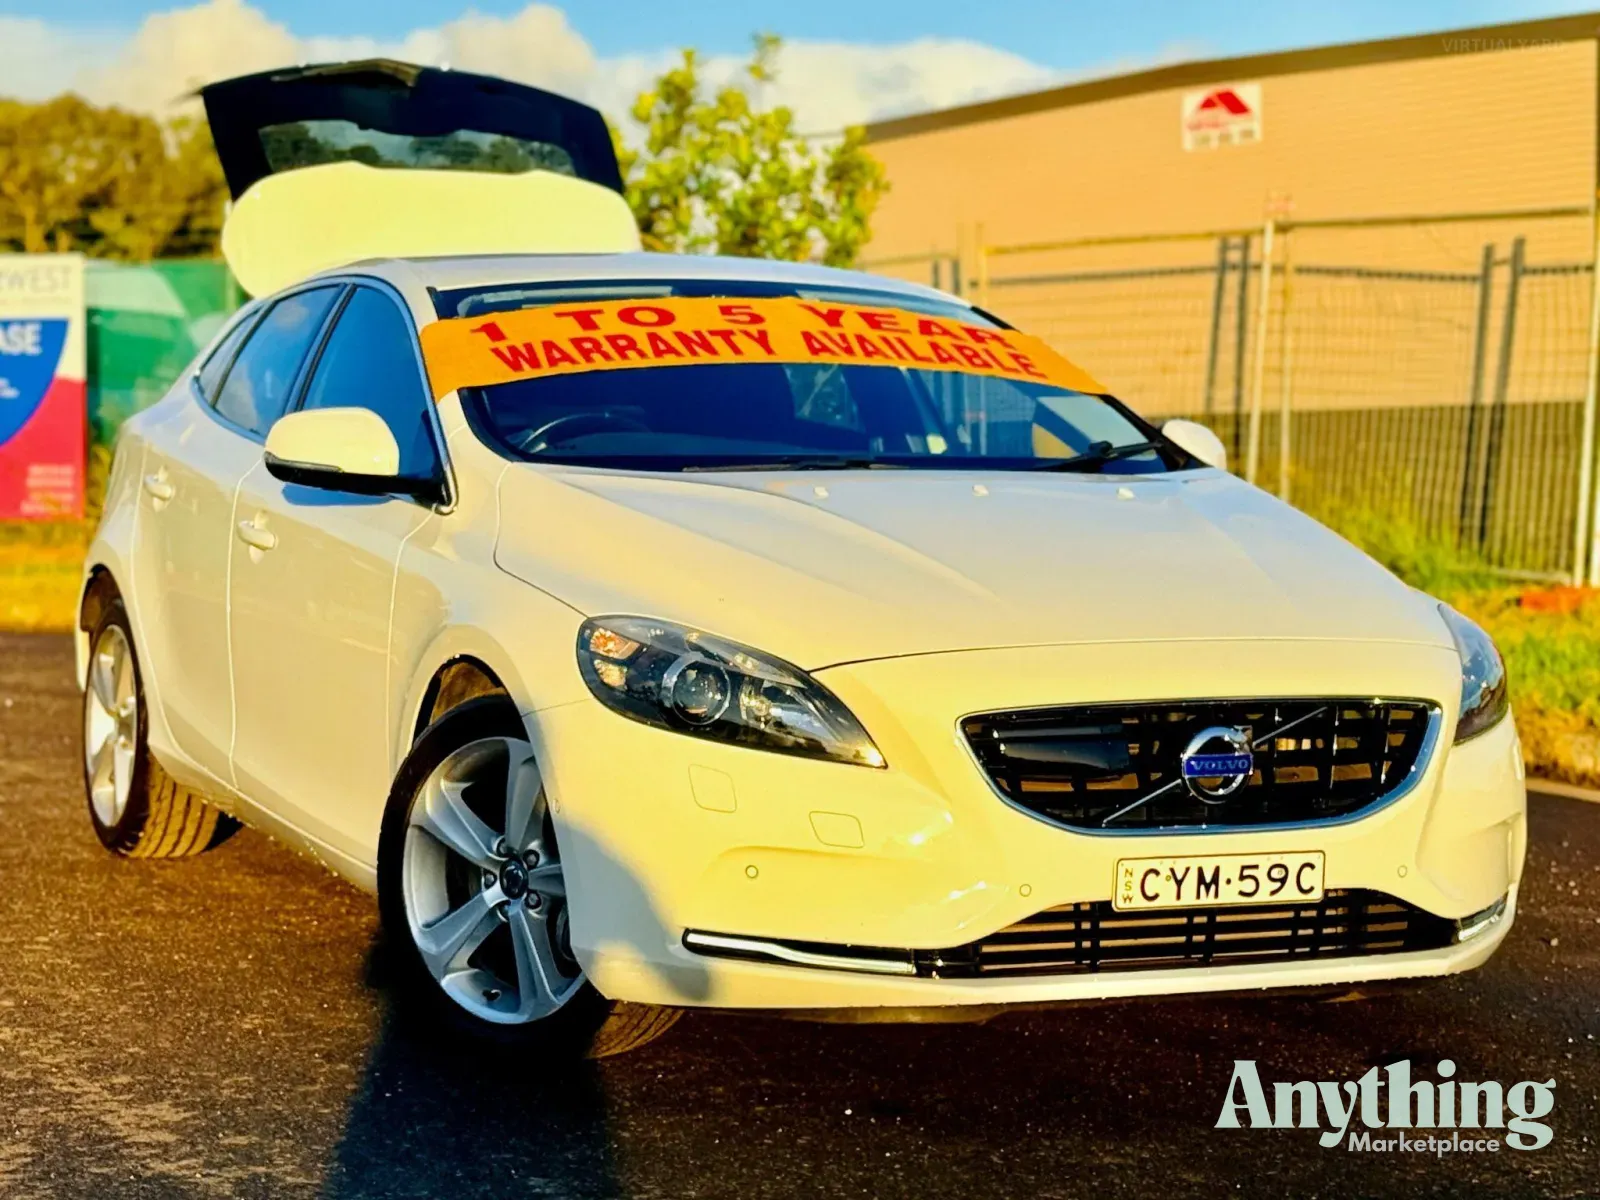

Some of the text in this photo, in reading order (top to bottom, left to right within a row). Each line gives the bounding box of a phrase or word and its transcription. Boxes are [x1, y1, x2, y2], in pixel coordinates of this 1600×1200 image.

[0, 265, 72, 292] WEST
[470, 304, 1018, 349] 1 TO 5 YEAR
[490, 329, 1049, 379] WARRANTY AVAILABLE
[1190, 759, 1249, 771] VOLVO
